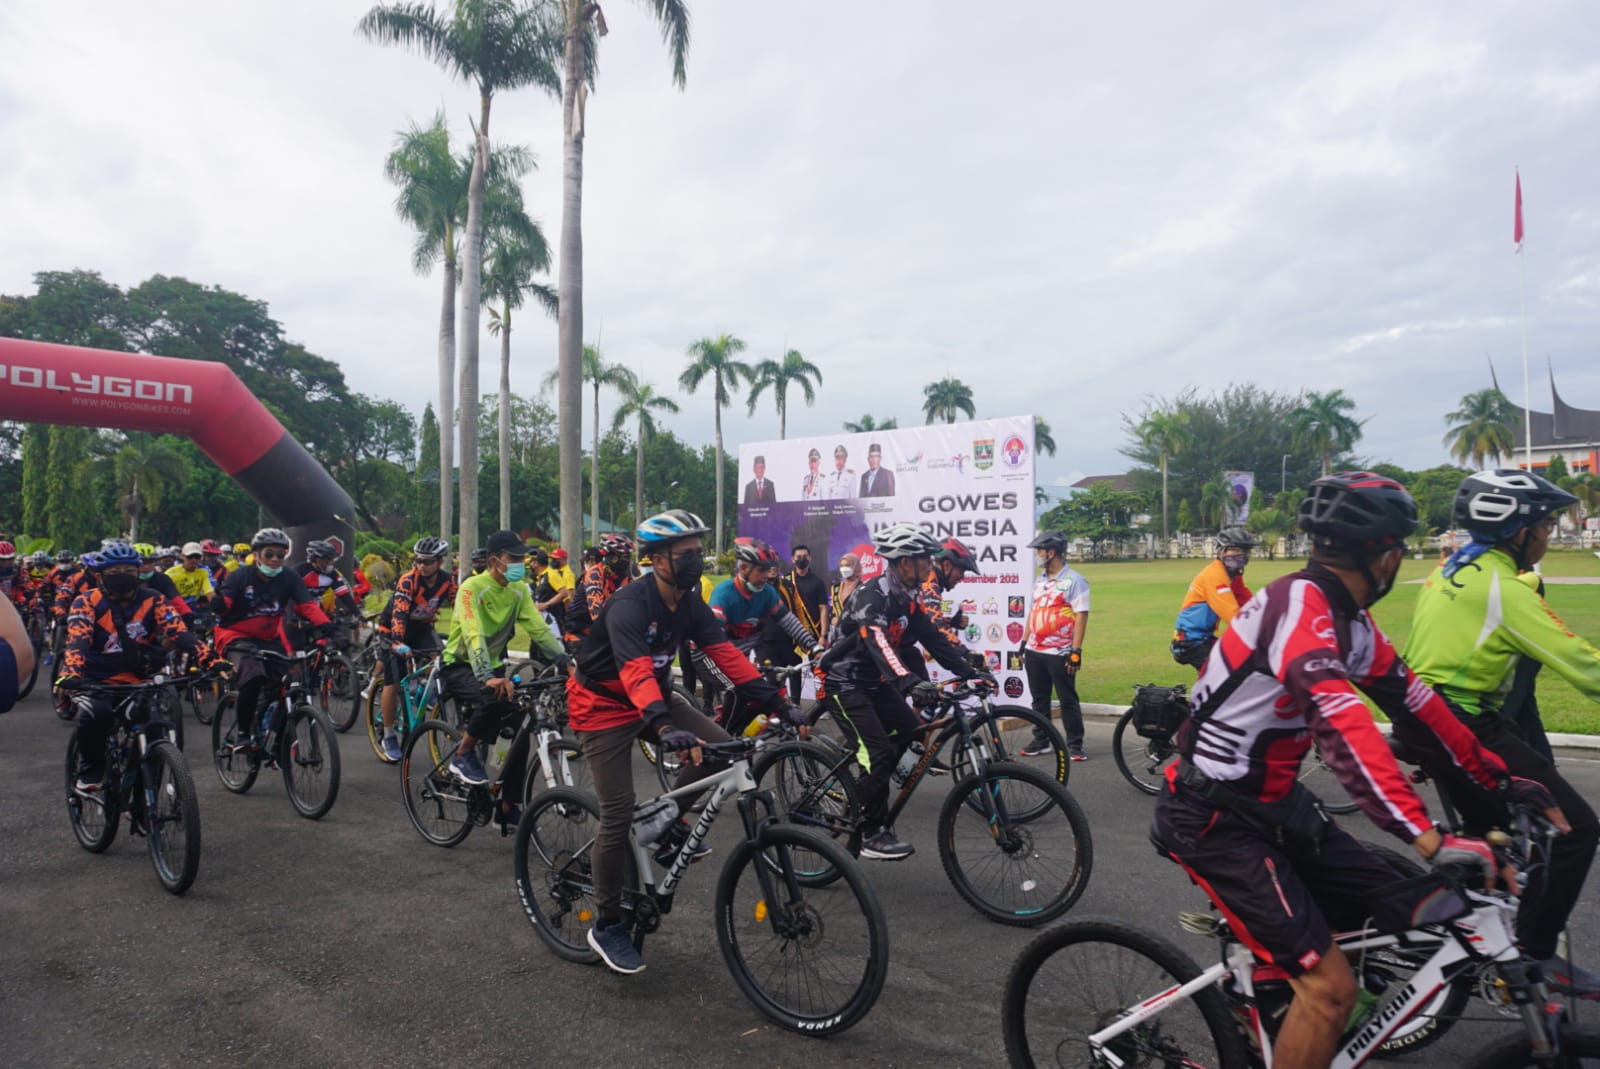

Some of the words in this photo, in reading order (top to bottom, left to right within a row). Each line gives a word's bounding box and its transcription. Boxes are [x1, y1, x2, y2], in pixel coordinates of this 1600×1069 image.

[0, 364, 193, 404] OLYGON
[918, 491, 1018, 513] GOWES
[960, 574, 997, 584] esember
[999, 575, 1020, 584] 2021
[663, 800, 721, 890] SHADOW
[797, 1014, 842, 1030] KENDA
[1345, 982, 1418, 1062] POLYGON
